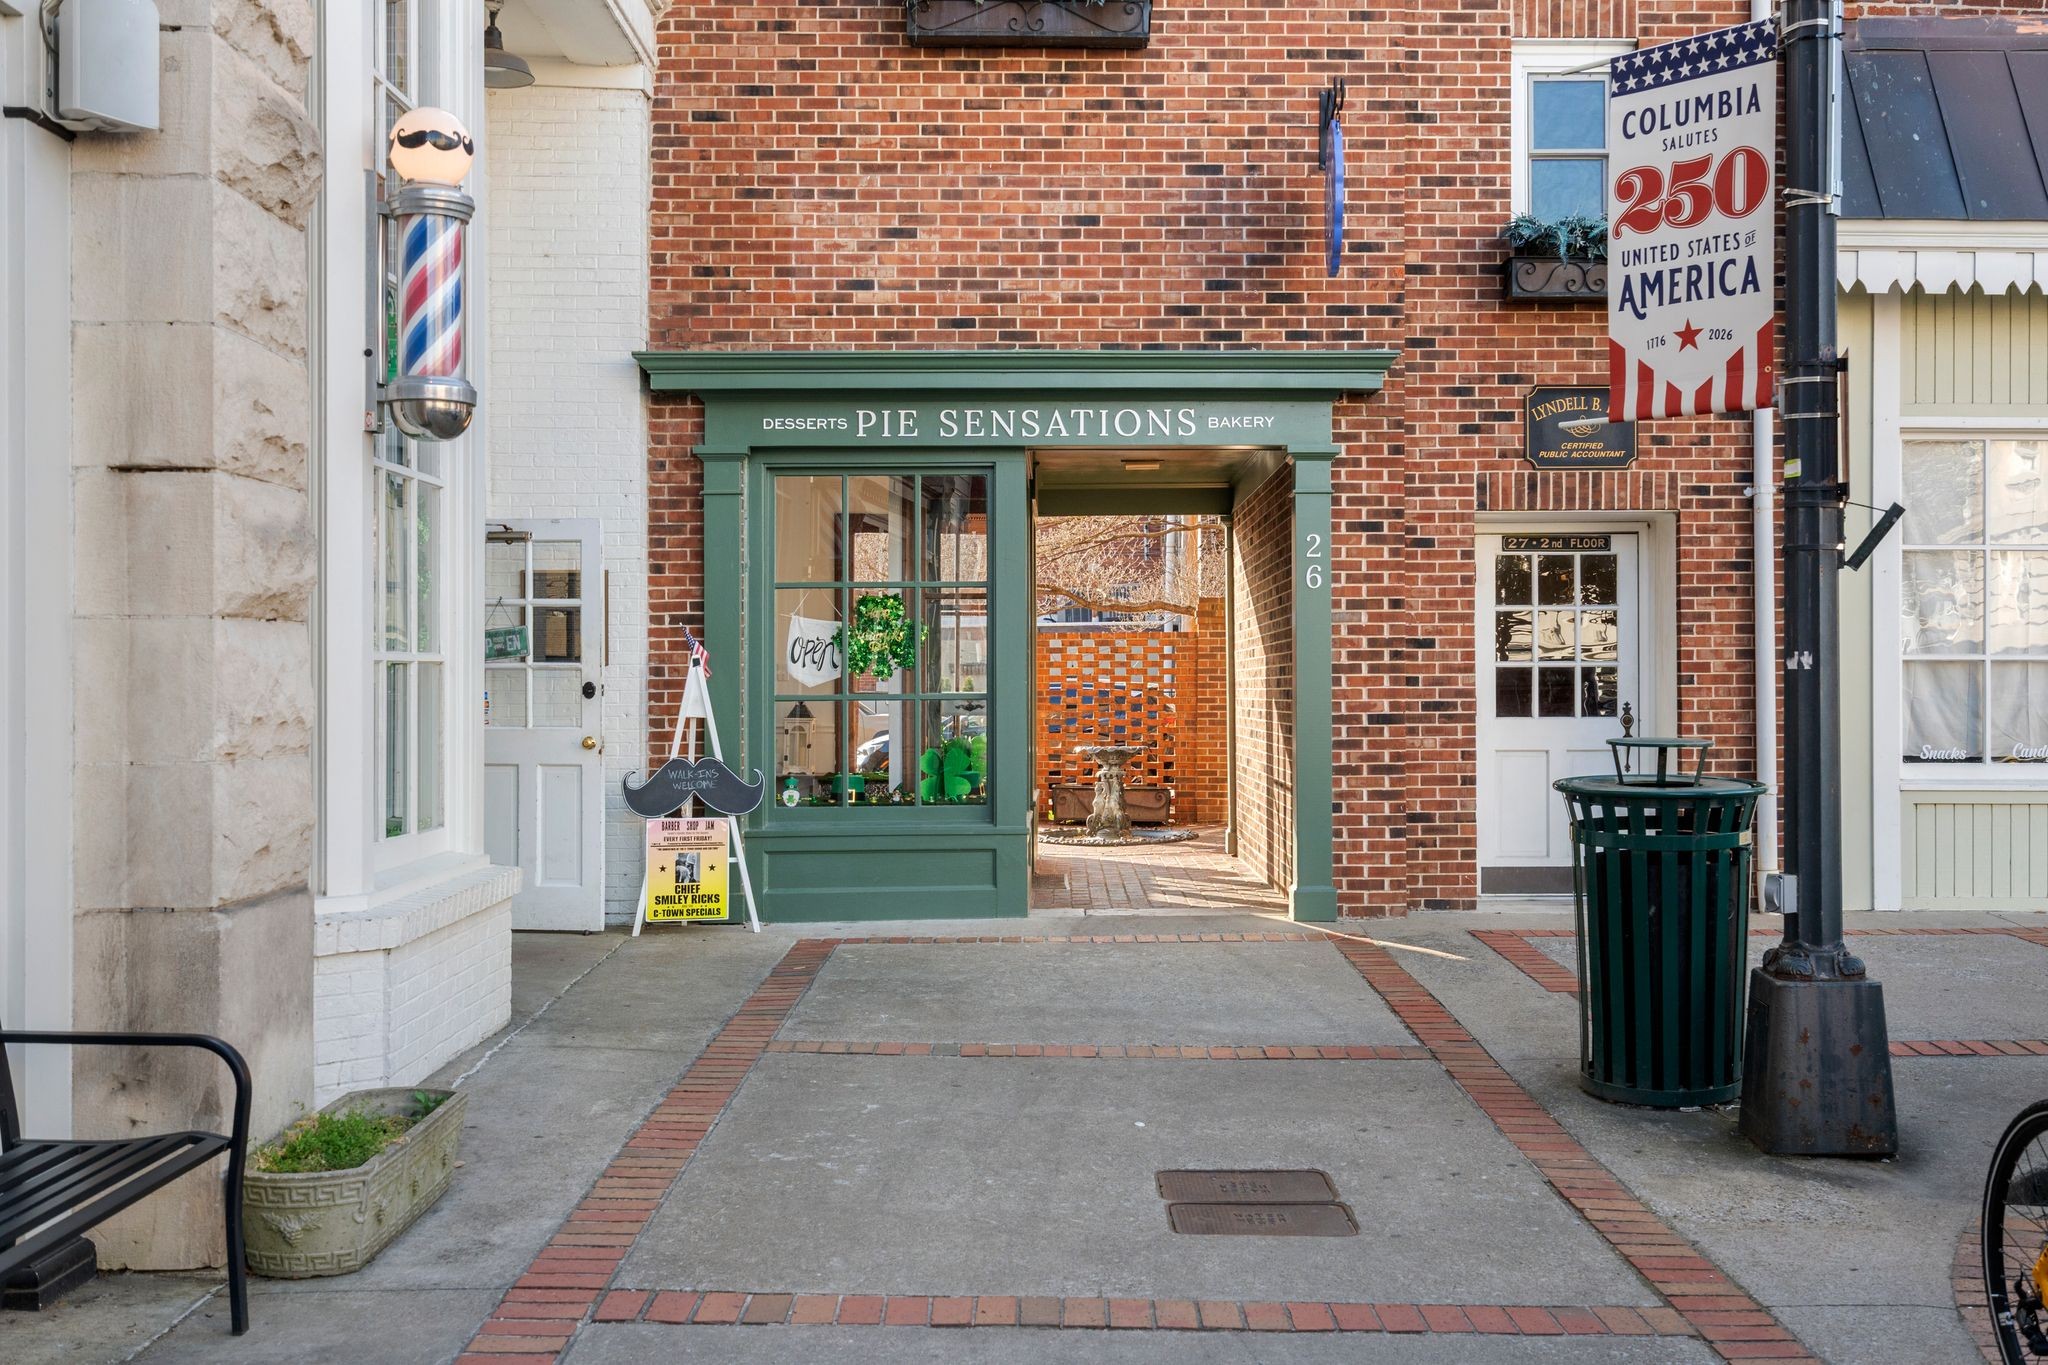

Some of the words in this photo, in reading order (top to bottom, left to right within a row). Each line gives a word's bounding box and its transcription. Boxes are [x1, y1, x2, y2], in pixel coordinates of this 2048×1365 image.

[1622, 83, 1761, 140] COLUMBIA
[1662, 128, 1718, 152] SALUTES
[1612, 145, 1770, 239] 250
[1622, 243, 1679, 267] UNITED
[1688, 232, 1740, 258] STATES
[1745, 232, 1756, 246] OF
[1618, 255, 1760, 320] AMERICA
[1647, 335, 1666, 350] 1776
[1709, 328, 1733, 340] 2026
[1531, 396, 1588, 421] LYNDELL
[1592, 397, 1602, 412] B.
[763, 418, 848, 430] DESSERTS
[856, 410, 918, 437] PIE
[939, 409, 1197, 437] SENSATIONS
[1208, 416, 1275, 429] BAKERY
[1561, 442, 1604, 450] CERTIFIED
[1539, 450, 1568, 458] PUBLIC
[1571, 450, 1626, 458] ACCOUNTANT
[1508, 538, 1528, 549] 27
[1570, 538, 1605, 548] FLOOR
[1920, 745, 1967, 760] Snacks
[668, 769, 719, 779] WALK-INS
[673, 780, 718, 790] WELCOME
[662, 821, 680, 831] BARBER
[686, 821, 699, 831] SHOP
[705, 820, 715, 831] JAM
[675, 884, 700, 895] CHIEF
[655, 894, 689, 905] SMILEY
[691, 893, 720, 904] RICKS
[653, 908, 684, 918] C-TOWN
[686, 907, 721, 917] SPECIALS
